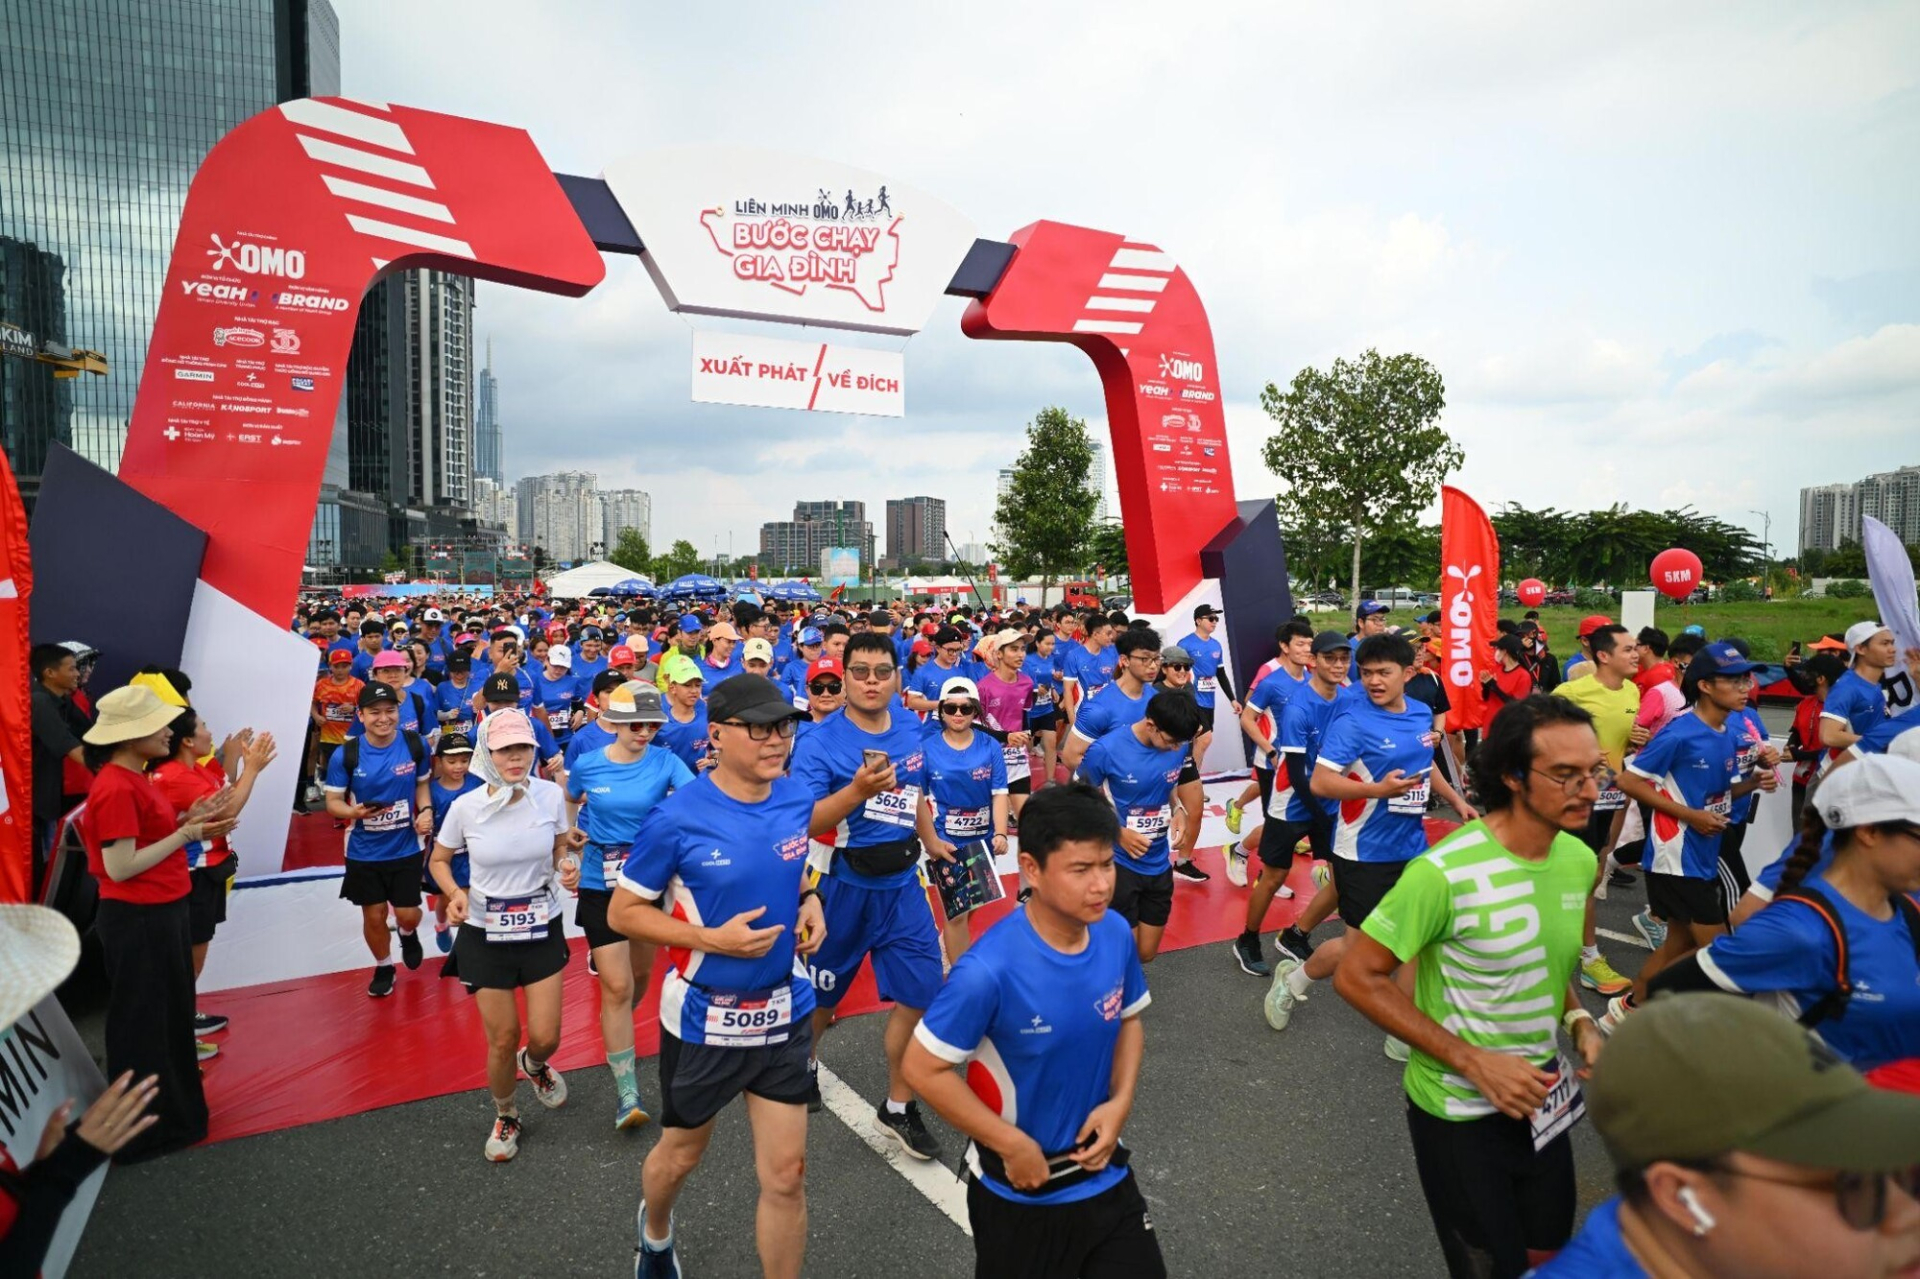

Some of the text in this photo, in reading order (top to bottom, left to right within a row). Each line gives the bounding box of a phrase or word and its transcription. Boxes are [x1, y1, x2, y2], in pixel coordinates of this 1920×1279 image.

[735, 198, 839, 220] LIÊN MINH OMO
[734, 219, 880, 257] BƯỚC CHẠY
[241, 244, 305, 279] OMO
[734, 251, 856, 282] GIA ĐÌNH
[0, 326, 33, 347] KIM
[3, 342, 34, 356] LAND
[177, 371, 212, 380] GARMIN
[700, 355, 807, 382] XUẤT PHÁT
[1173, 359, 1203, 382] OMO
[827, 369, 899, 393] VỀ ĐÍCH
[1664, 569, 1692, 583] 5KM
[1525, 586, 1542, 595] 5KM
[1449, 600, 1473, 687] OMO
[875, 792, 907, 810] 5626
[954, 816, 982, 826] 4722
[1136, 816, 1164, 828] 5975
[499, 912, 536, 927] 5193
[809, 964, 836, 991] 10
[722, 1009, 779, 1028] 5089
